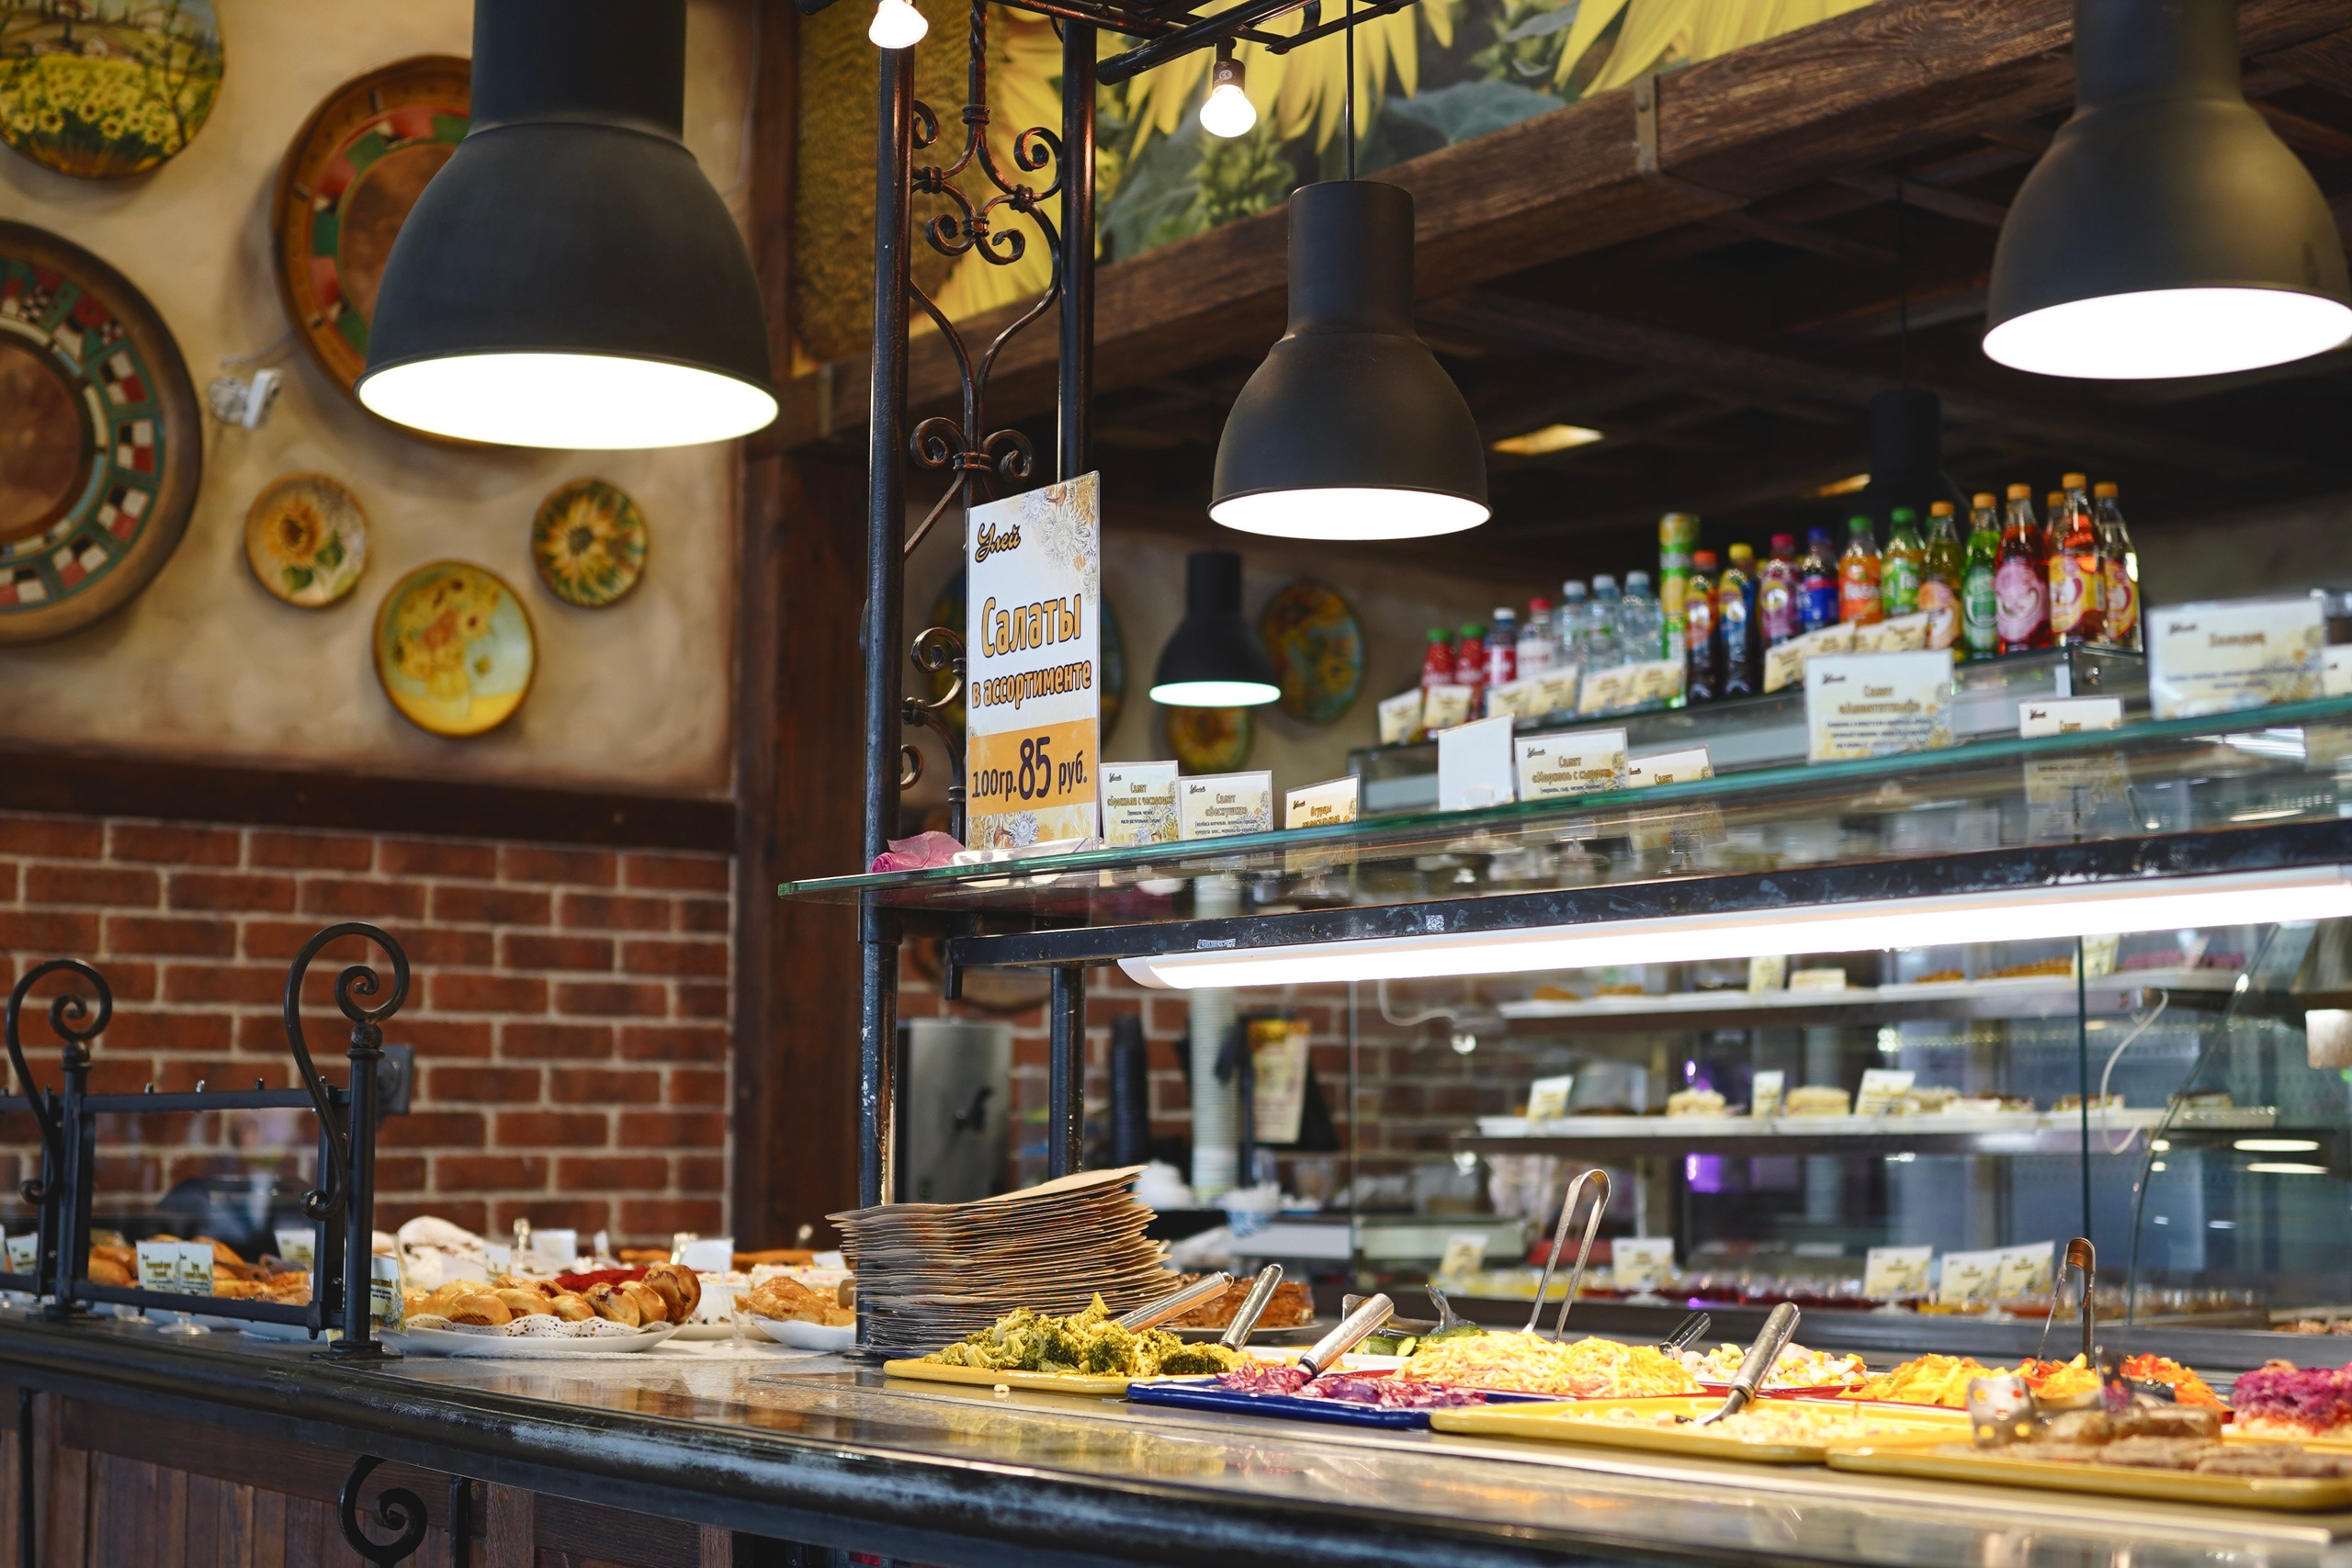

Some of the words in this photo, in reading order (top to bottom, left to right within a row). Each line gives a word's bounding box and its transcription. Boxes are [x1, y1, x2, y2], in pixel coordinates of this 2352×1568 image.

[975, 522, 1022, 563] Улей
[981, 593, 1081, 658] Салаты
[972, 682, 981, 708] в
[983, 660, 1091, 710] ассортименте
[1558, 756, 1581, 768] Салат
[972, 768, 1017, 802] 100гр.
[1018, 736, 1052, 800] 85
[1058, 750, 1088, 795] руб.
[1532, 770, 1572, 784] «Морковь
[1573, 771, 1578, 781] с
[1654, 773, 1674, 784] Салат
[1130, 783, 1147, 794] Салат
[1216, 794, 1236, 804] Салат
[1311, 805, 1331, 818] Огурцы
